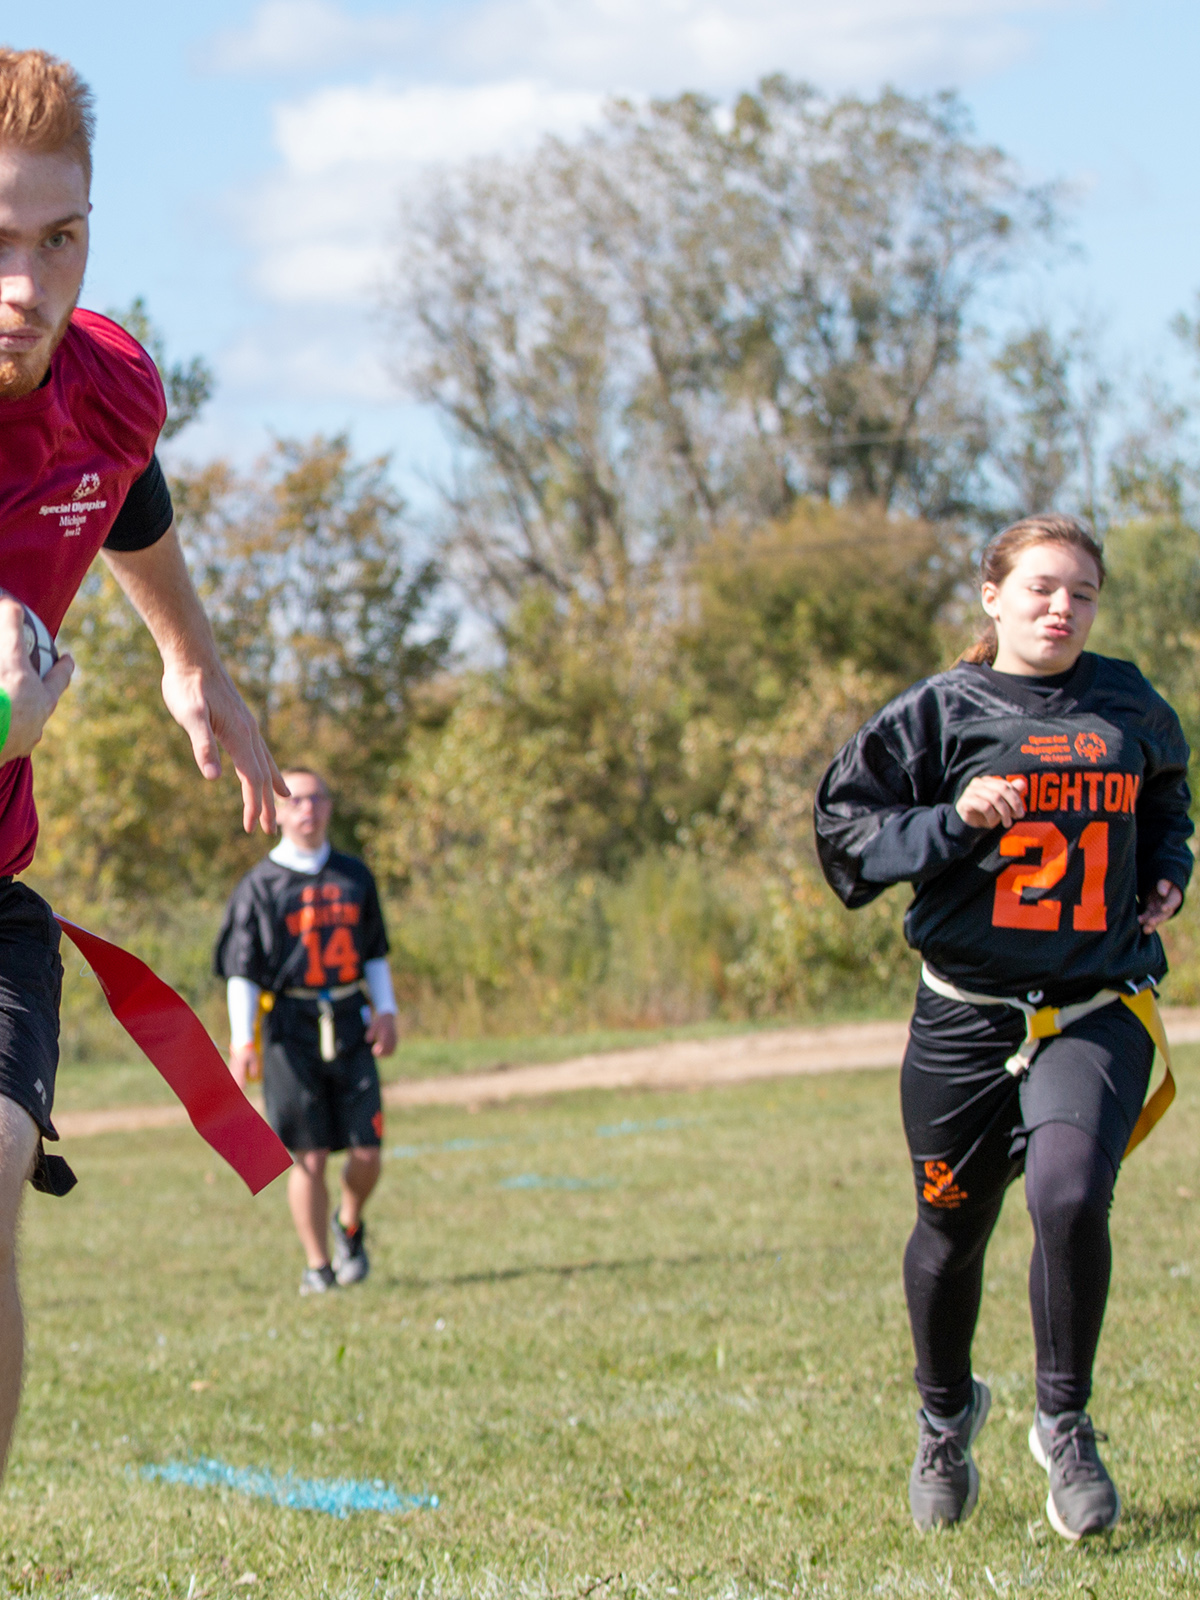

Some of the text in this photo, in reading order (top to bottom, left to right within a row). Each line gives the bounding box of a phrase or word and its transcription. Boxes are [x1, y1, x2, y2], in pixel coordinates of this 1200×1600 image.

[39, 500, 107, 516] Special Olympics
[991, 821, 1109, 931] 21
[303, 927, 359, 987] 14
